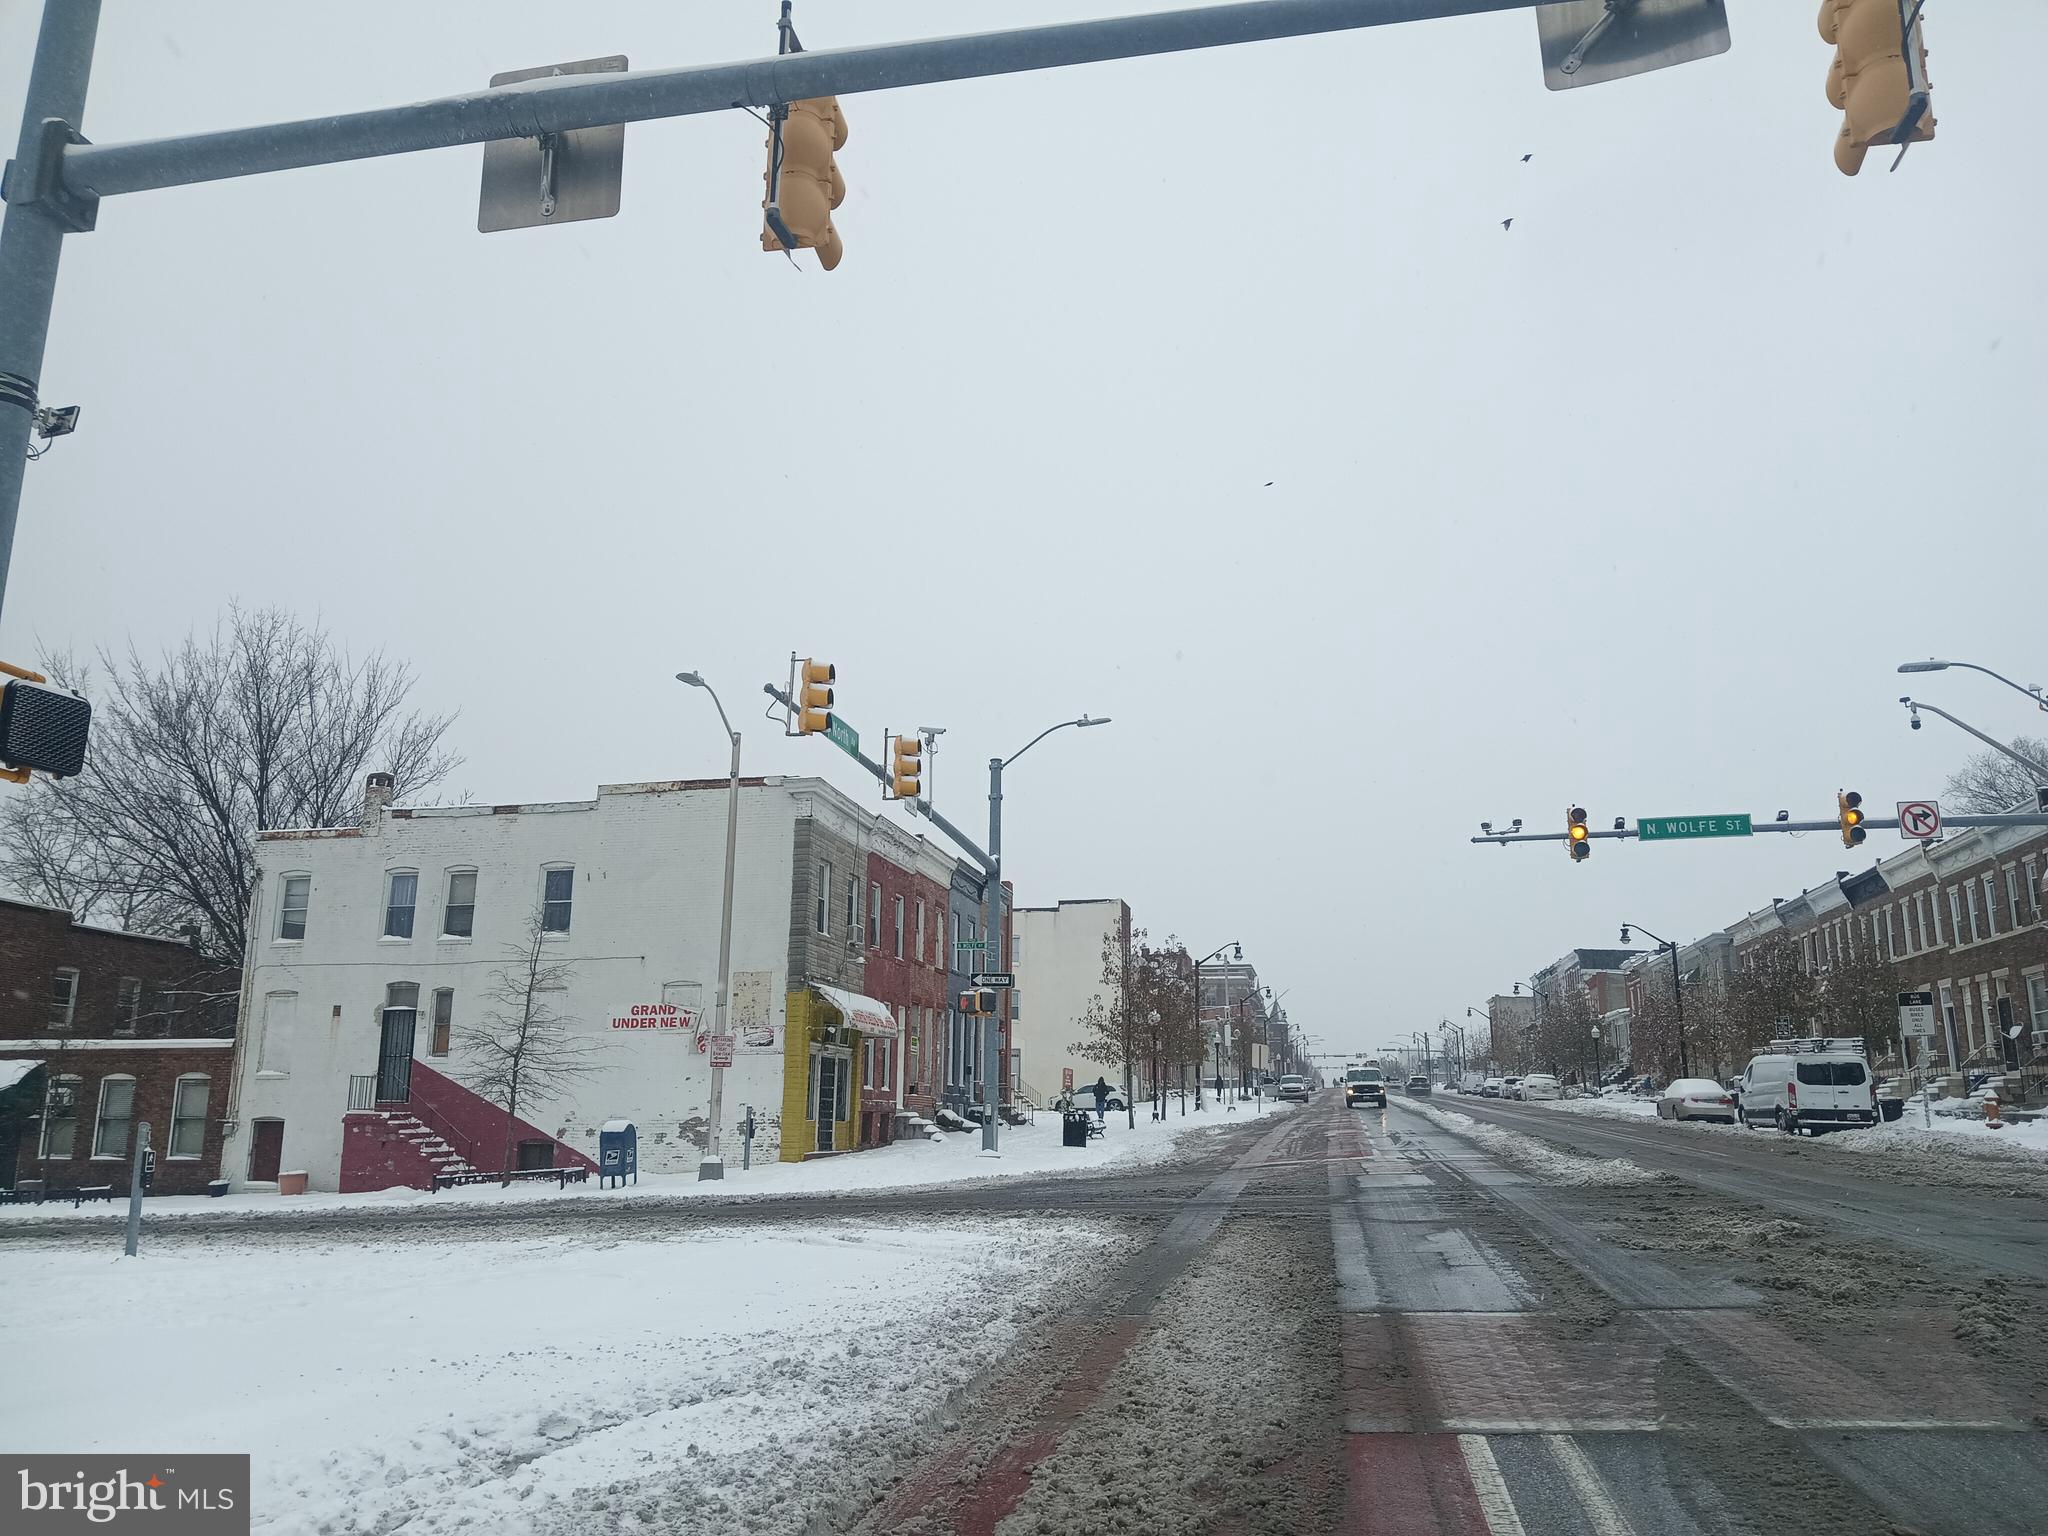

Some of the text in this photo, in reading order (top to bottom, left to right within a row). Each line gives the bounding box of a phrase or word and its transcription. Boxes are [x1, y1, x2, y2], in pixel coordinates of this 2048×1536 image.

[832, 721, 849, 746] North
[1646, 819, 1743, 835] N. WOLFE ST.
[630, 1005, 677, 1016] GRAND
[612, 1017, 691, 1029] UNDER NEW
